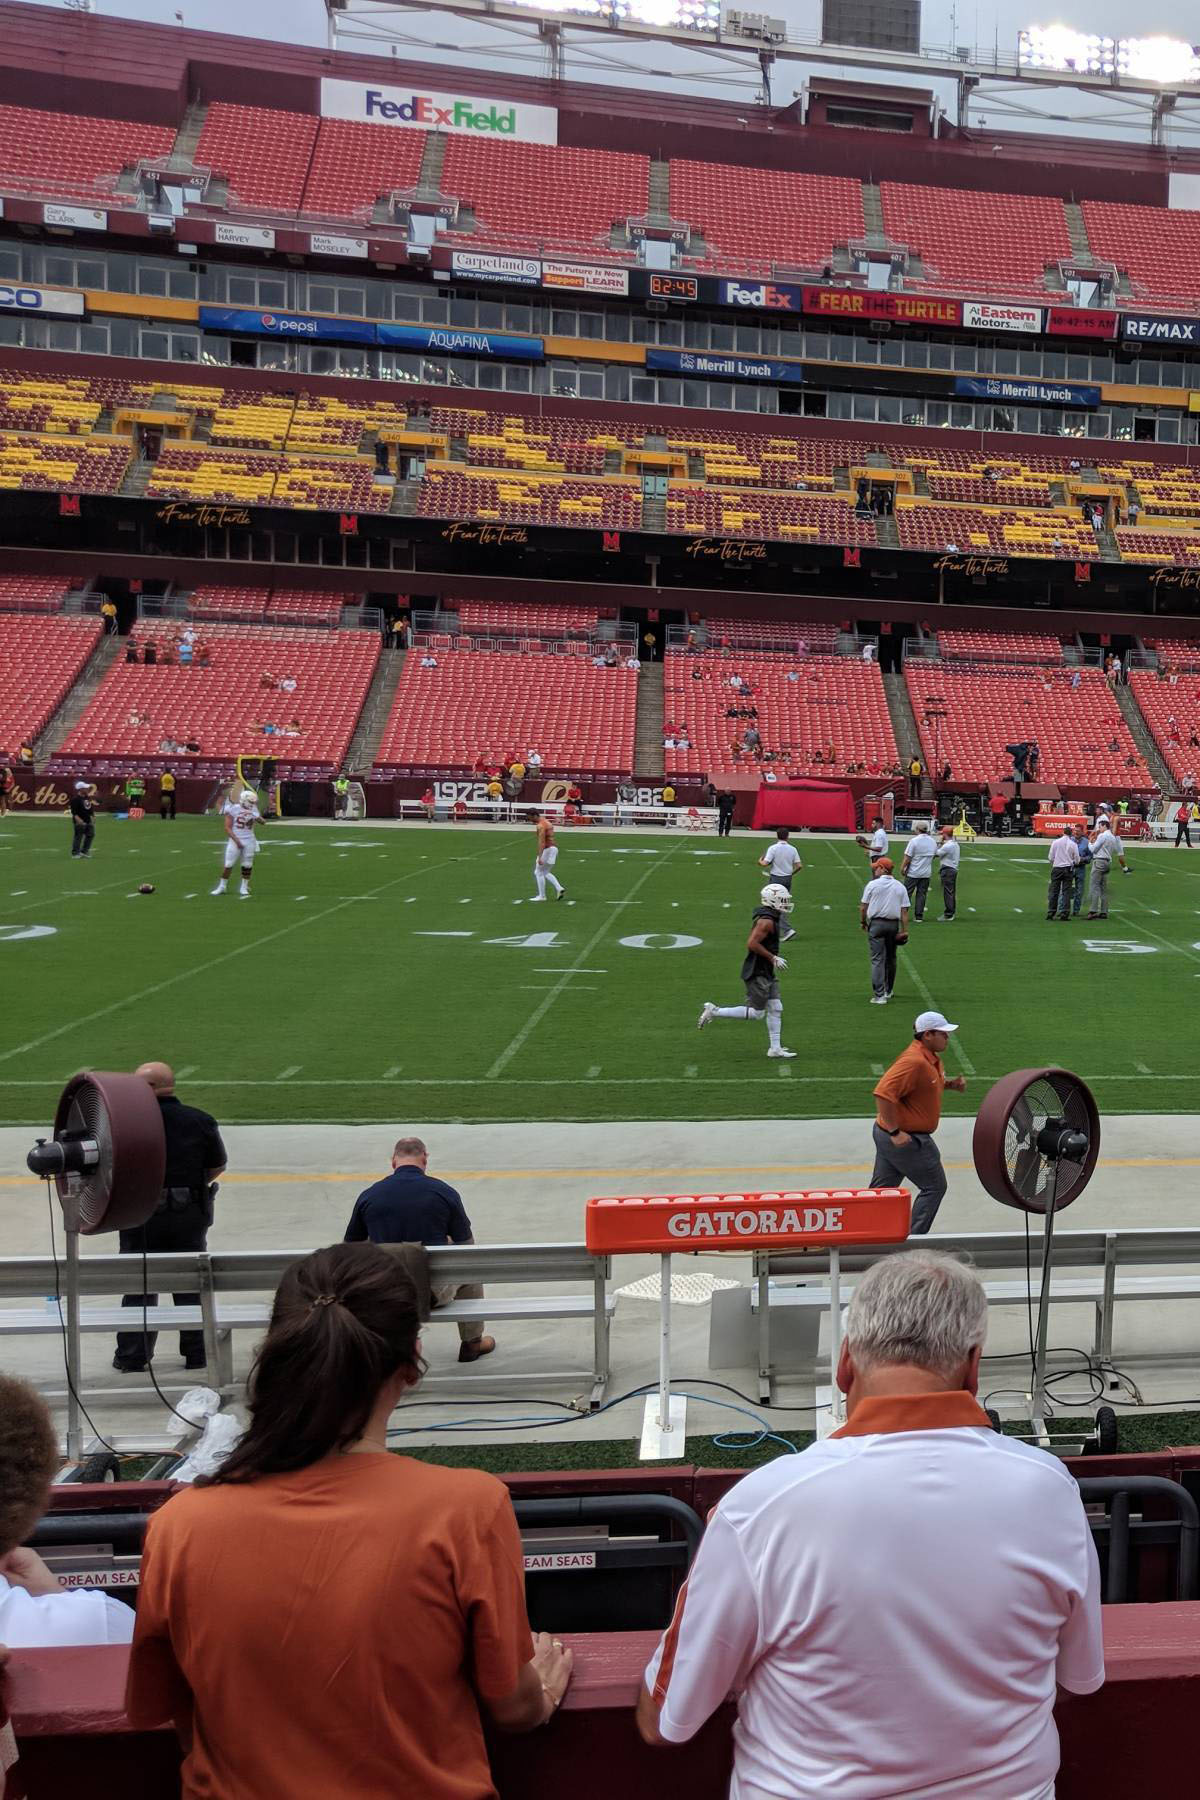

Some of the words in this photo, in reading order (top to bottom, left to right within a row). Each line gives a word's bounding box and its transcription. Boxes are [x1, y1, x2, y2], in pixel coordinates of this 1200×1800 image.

[366, 91, 516, 134] FedExField
[147, 171, 160, 181] 451
[190, 177, 205, 186] 452
[47, 207, 67, 217] Gary
[398, 202, 411, 211] 452
[46, 214, 76, 224] CLARK
[218, 226, 234, 235] Ken
[633, 228, 646, 236] 453
[672, 232, 685, 240] 454
[217, 234, 250, 244] HARVEY
[313, 236, 332, 245] Mark
[313, 243, 351, 254] MOSELEY
[457, 253, 524, 273] Carpetland
[456, 271, 537, 286] www.mycarpetland.com
[547, 264, 563, 274] The
[565, 266, 594, 277] Future
[595, 269, 603, 277] Is
[605, 270, 623, 278] Now
[545, 274, 583, 287] Support
[586, 277, 624, 288] LEARN
[652, 278, 696, 297] 82:45
[727, 282, 792, 309] FedEx
[969, 306, 980, 315] At
[981, 306, 1036, 321] Eastern
[280, 319, 317, 333] pepsi
[1126, 320, 1194, 339] RE/MAX
[427, 330, 490, 351] AQUAFINA
[697, 358, 735, 373] Merrill
[738, 362, 771, 377] Lynch
[1002, 383, 1037, 398] Merrill
[1041, 387, 1071, 400] Lynch
[59, 495, 81, 516] M
[340, 513, 358, 534] M
[603, 532, 620, 552] M
[843, 547, 861, 567] M
[1075, 562, 1091, 582] M
[10, 784, 30, 805] to
[34, 784, 70, 805] the
[433, 781, 488, 801] 1972
[667, 1207, 844, 1238] GATORADE
[556, 1555, 593, 1567] SEATS
[58, 1573, 107, 1586] DREAM
[111, 1571, 141, 1584] SEAT
